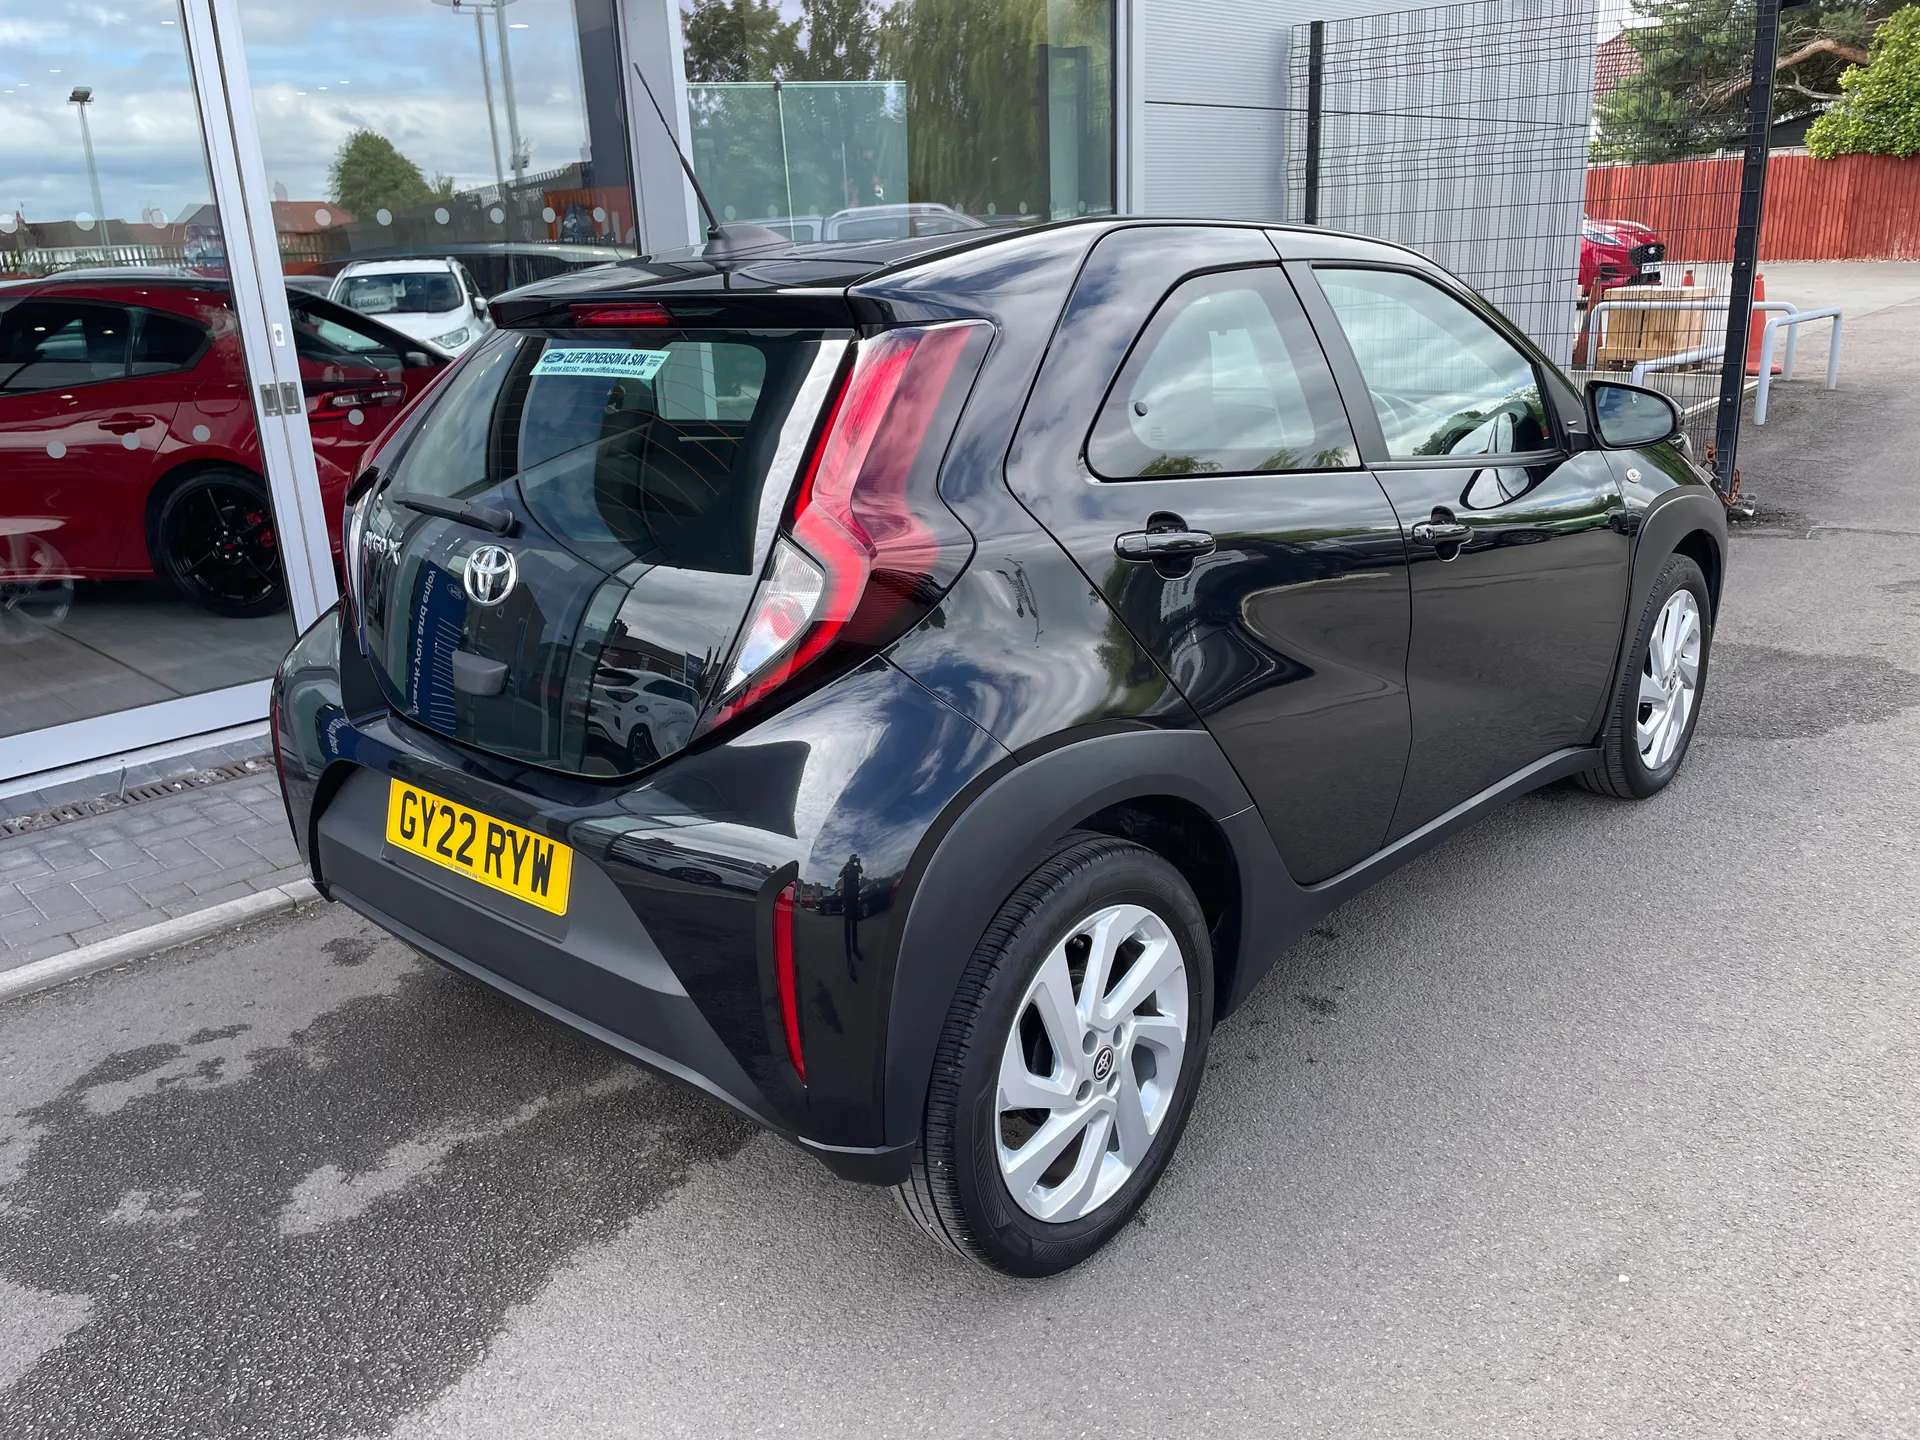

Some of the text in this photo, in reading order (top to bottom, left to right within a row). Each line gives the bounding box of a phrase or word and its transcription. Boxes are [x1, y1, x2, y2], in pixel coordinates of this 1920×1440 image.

[564, 352, 586, 364] CLIFF
[583, 352, 624, 366] DICKENSON
[621, 353, 632, 366] &
[628, 354, 648, 366] SON
[400, 790, 555, 897] GY22 RYW
